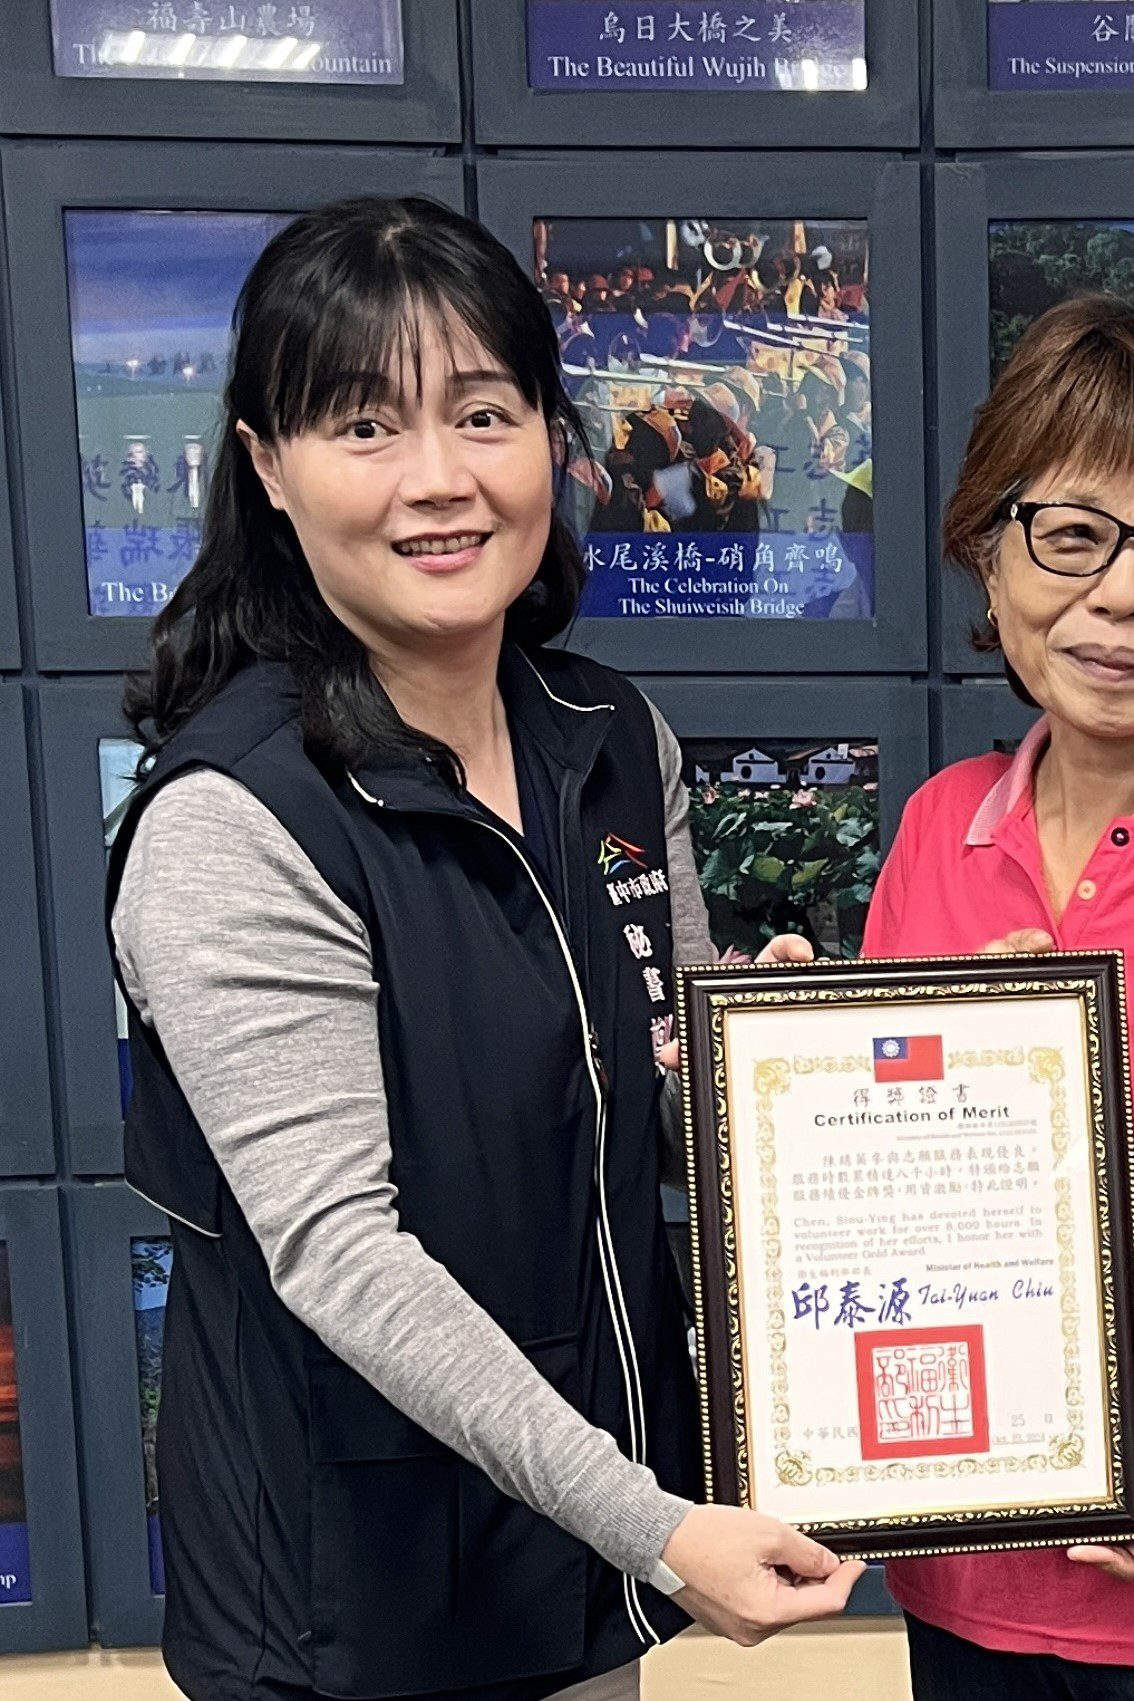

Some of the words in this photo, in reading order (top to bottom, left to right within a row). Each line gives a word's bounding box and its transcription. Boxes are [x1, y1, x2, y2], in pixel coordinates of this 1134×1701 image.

[599, 11, 793, 44] 烏日大橋之美
[302, 52, 392, 73] ountain
[548, 56, 589, 77] The
[597, 56, 694, 77] Beautiful
[702, 56, 766, 84] Wujih
[1008, 57, 1040, 75] The
[101, 582, 144, 602] The
[628, 578, 659, 594] The
[664, 577, 759, 594] Celebration
[764, 578, 789, 594] On
[618, 598, 650, 615] The
[750, 598, 805, 619] Bridge
[814, 1109, 931, 1128] Certification
[938, 1107, 956, 1121] of
[963, 1106, 1010, 1120] Merit
[930, 1208, 976, 1220] devoted
[983, 1205, 1025, 1218] herself
[1030, 1205, 1042, 1215] to
[794, 1229, 851, 1239] volunteer
[857, 1226, 887, 1236] work
[893, 1225, 909, 1235] for
[915, 1224, 940, 1233] over
[863, 1238, 874, 1247] of
[880, 1237, 898, 1247] her
[995, 1231, 1014, 1240] her
[1019, 1229, 1043, 1239] with
[926, 1263, 961, 1272] Minister
[963, 1262, 972, 1270] of
[974, 1260, 1002, 1269] Health
[1004, 1259, 1019, 1267] and
[1021, 1258, 1054, 1266] Welfare
[1012, 1279, 1055, 1300] Chiu
[792, 1277, 912, 1330] 邱泰源
